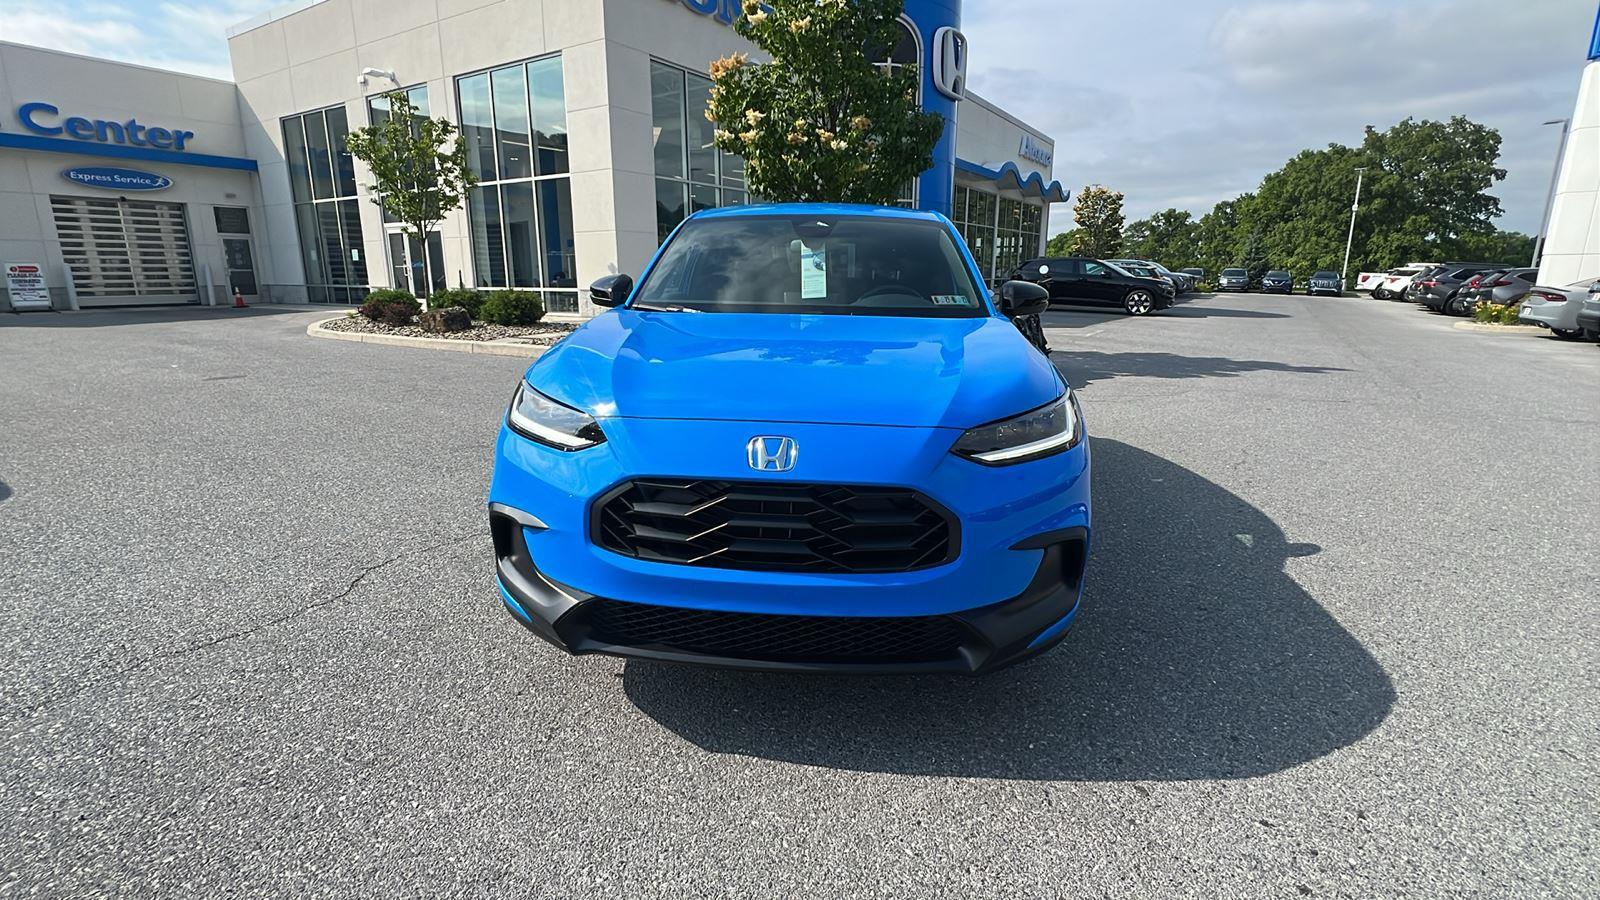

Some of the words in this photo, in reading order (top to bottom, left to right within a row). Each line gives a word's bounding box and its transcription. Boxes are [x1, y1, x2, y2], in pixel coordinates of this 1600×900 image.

[18, 102, 194, 150] Center
[70, 171, 112, 183] Express
[114, 174, 151, 185] Service
